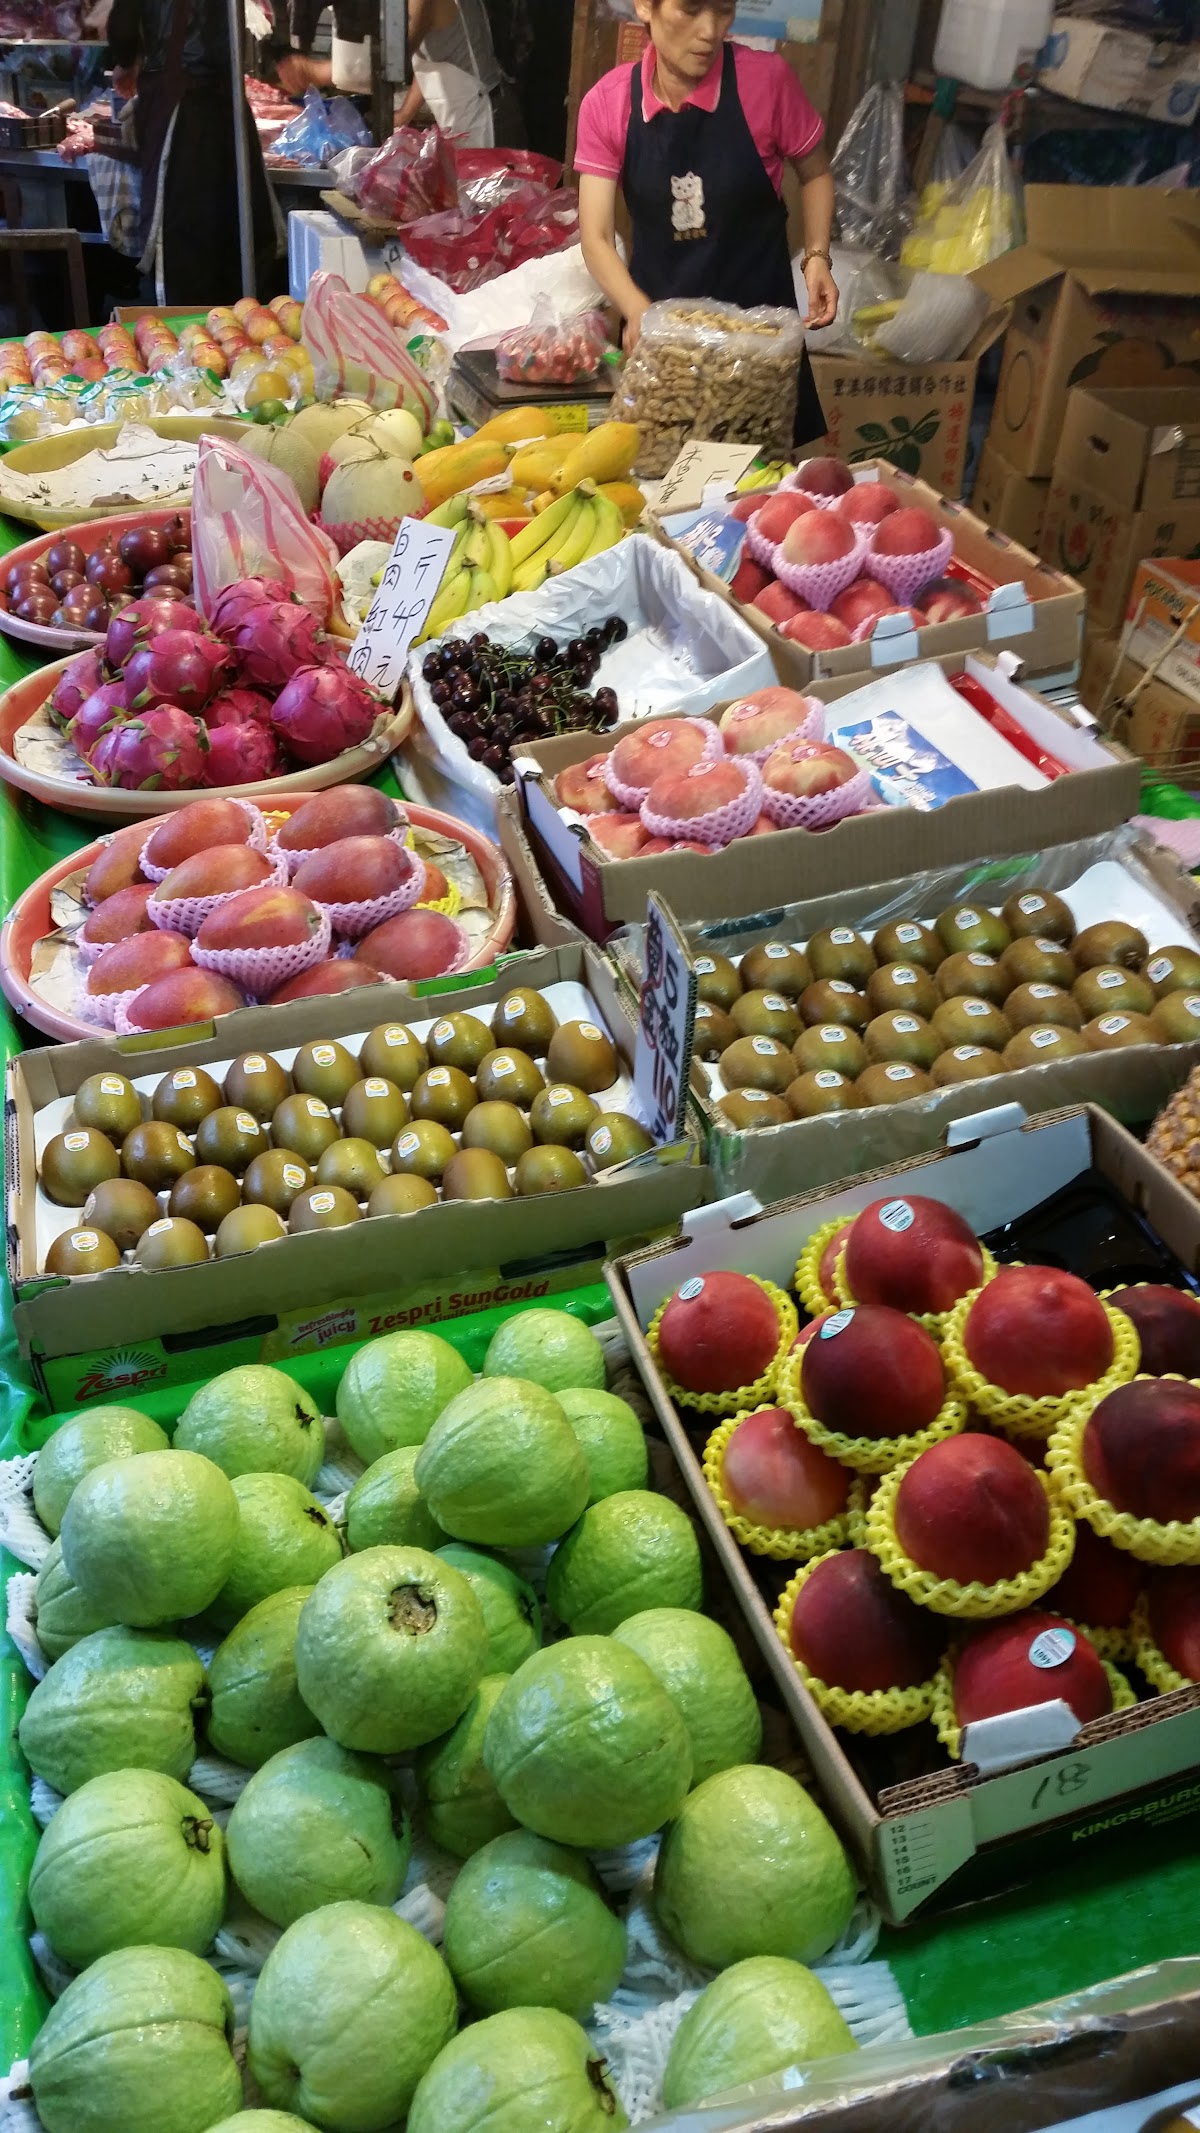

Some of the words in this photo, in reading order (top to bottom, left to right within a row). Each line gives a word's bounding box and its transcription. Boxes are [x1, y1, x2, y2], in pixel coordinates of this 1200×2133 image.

[368, 1295, 442, 1335] Zespri
[447, 1280, 550, 1310] SunGold
[317, 1318, 357, 1344] juicy
[74, 1363, 168, 1402] Zespri
[1031, 1762, 1092, 1810] 18
[890, 1824, 905, 1834] 12
[892, 1835, 907, 1845] 13
[893, 1845, 908, 1855] 14
[895, 1855, 910, 1865] 15
[897, 1866, 911, 1876] 16
[897, 1876, 937, 1894] COUNT
[898, 1876, 912, 1886] 17
